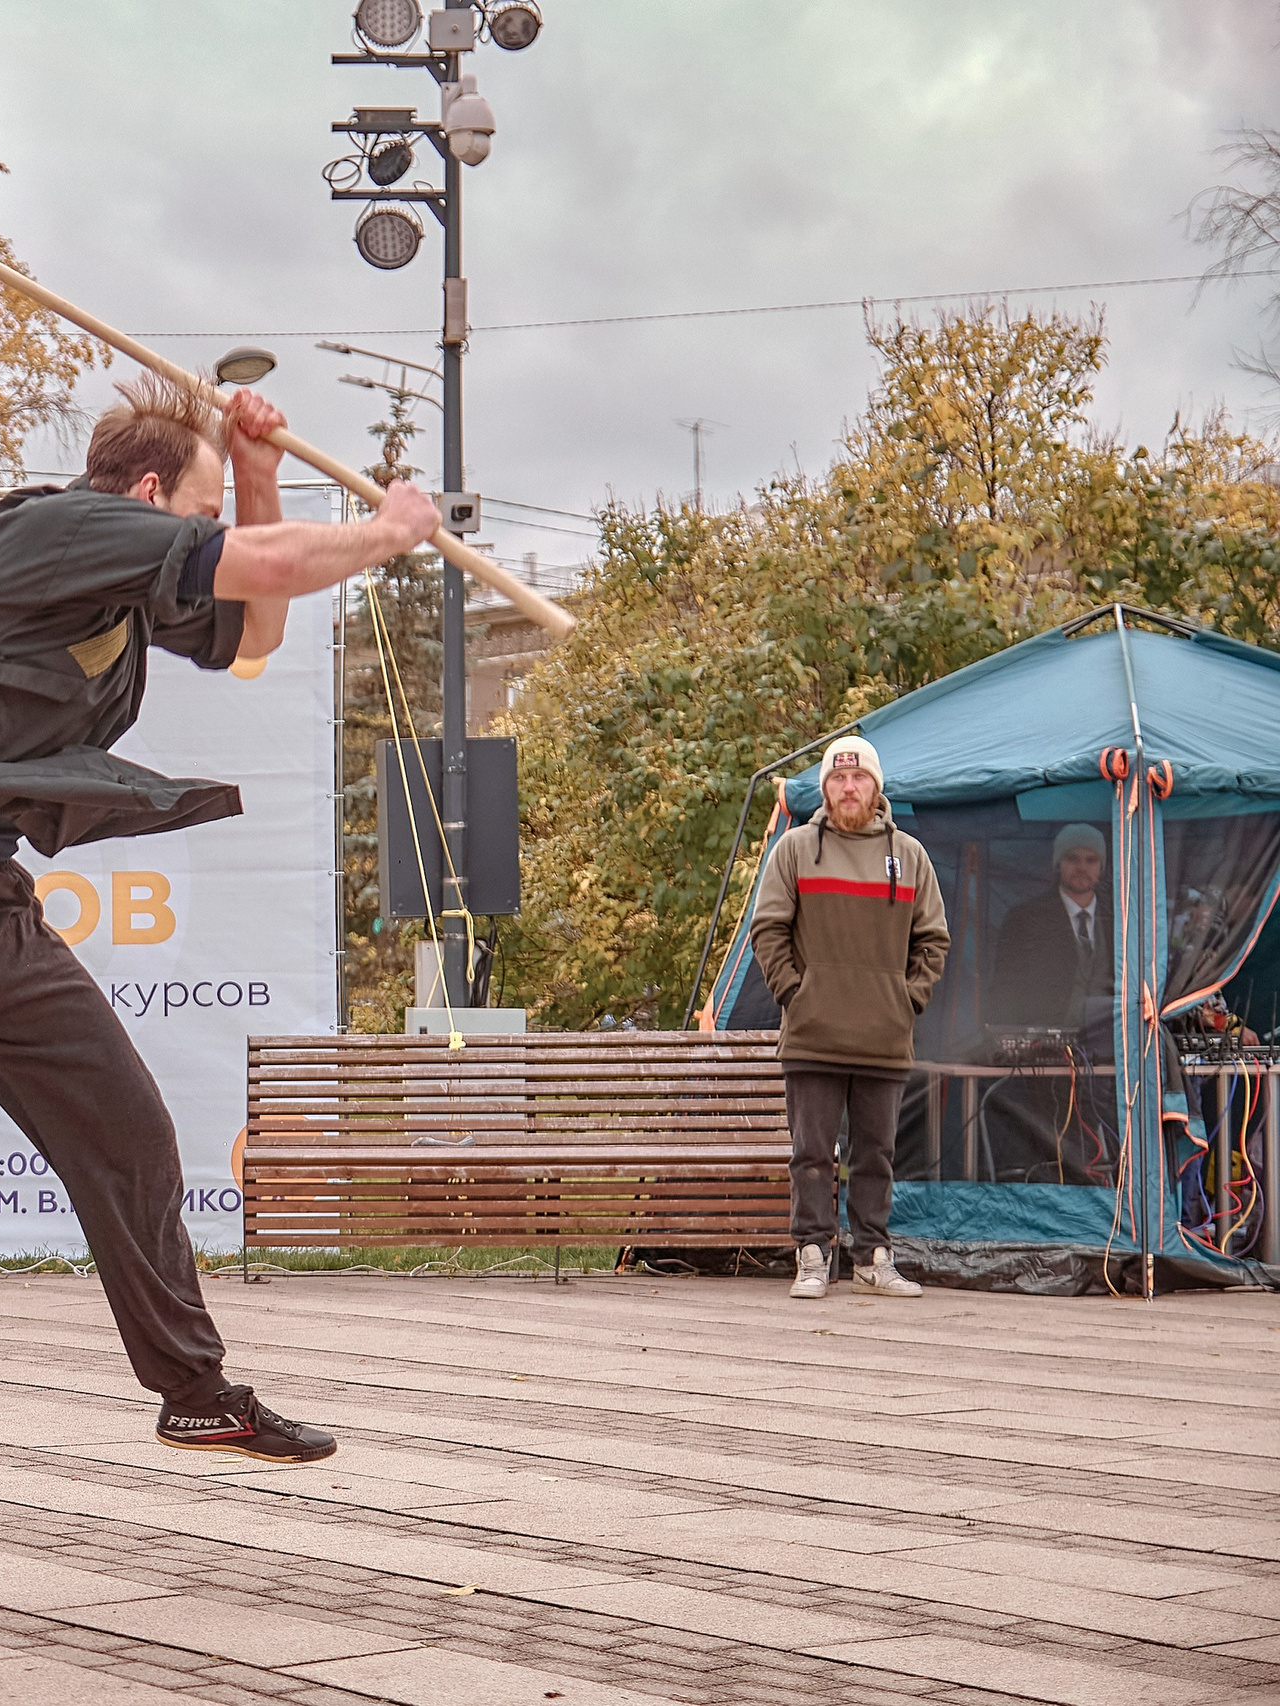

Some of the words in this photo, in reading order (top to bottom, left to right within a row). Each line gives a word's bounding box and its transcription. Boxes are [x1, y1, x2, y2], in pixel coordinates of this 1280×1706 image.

[111, 981, 270, 1017] курсов
[38, 1190, 75, 1214] В.
[167, 1415, 221, 1428] FEIYUE
